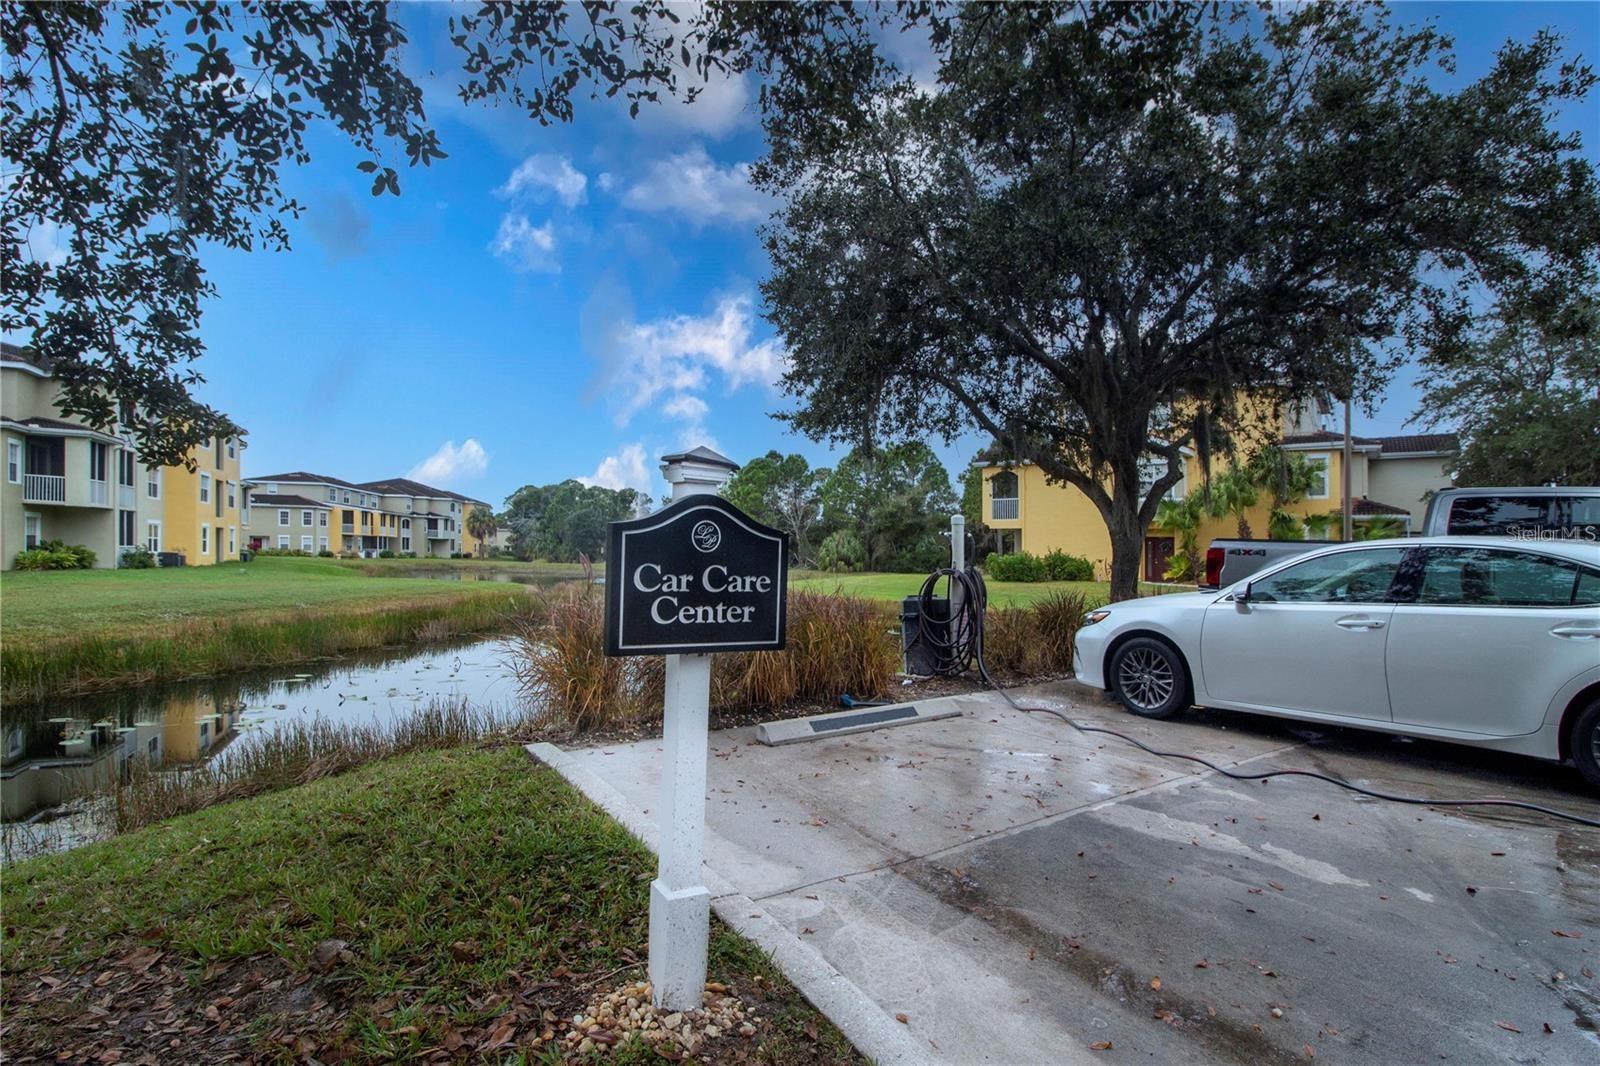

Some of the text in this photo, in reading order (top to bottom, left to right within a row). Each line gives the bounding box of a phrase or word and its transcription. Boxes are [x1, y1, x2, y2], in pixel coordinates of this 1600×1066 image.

[633, 563, 771, 593] Car Care
[651, 596, 756, 625] Center
